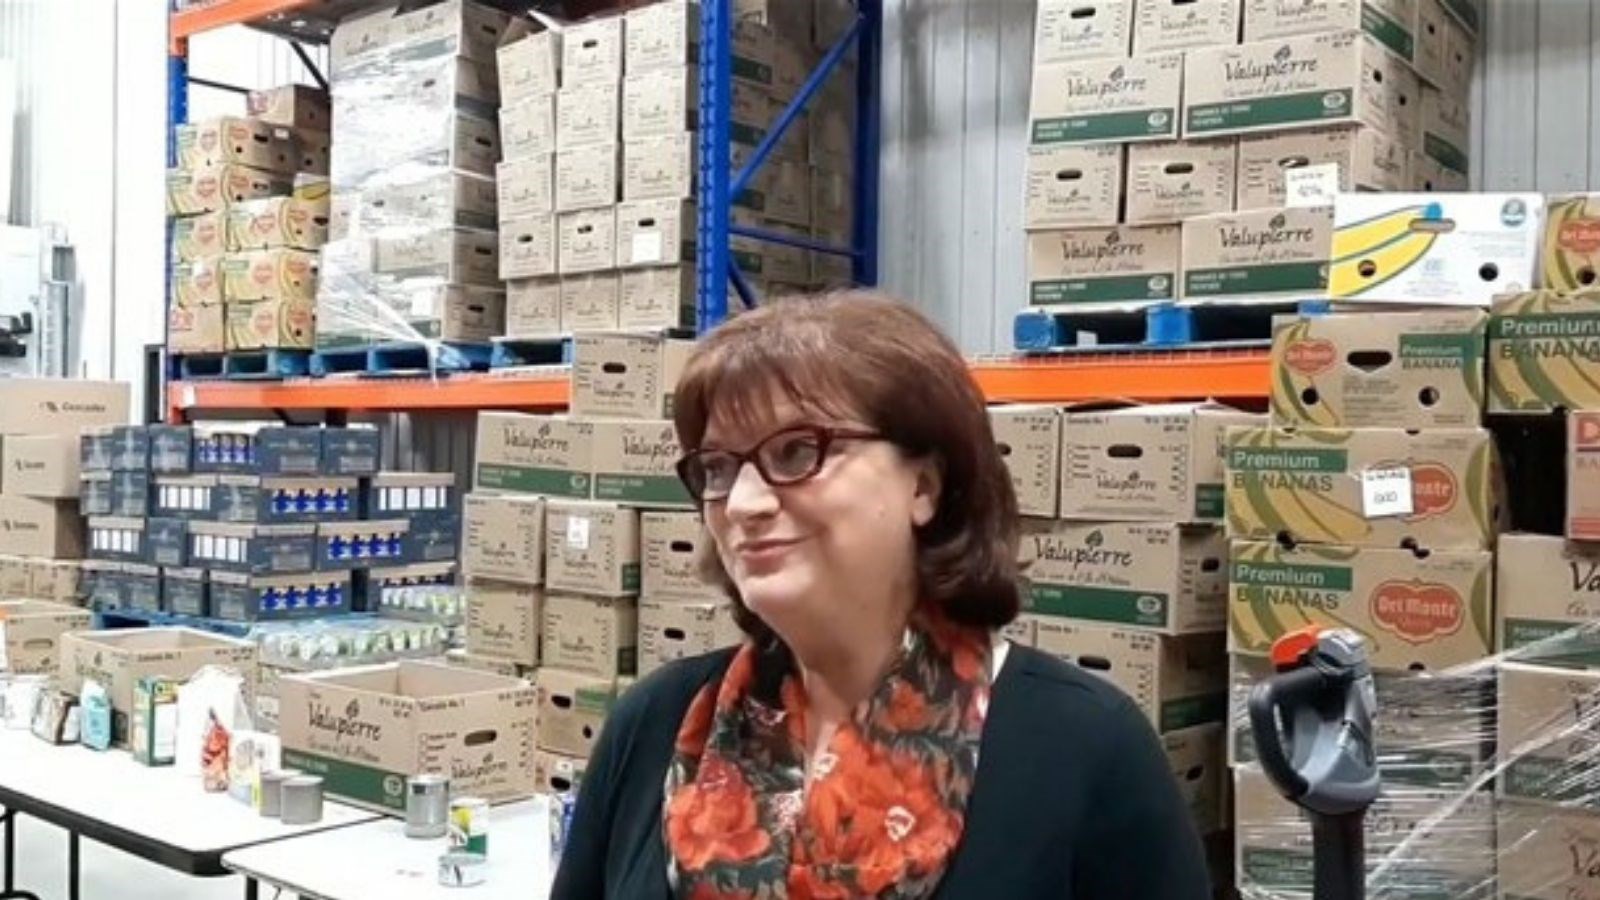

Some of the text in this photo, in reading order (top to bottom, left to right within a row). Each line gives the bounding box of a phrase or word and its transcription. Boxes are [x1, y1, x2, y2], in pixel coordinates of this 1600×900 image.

[1225, 58, 1317, 82] Valupierre
[1067, 76, 1146, 99] Valupierre
[1220, 226, 1313, 251] Valupierre
[1061, 240, 1144, 262] Valupierre
[1502, 318, 1600, 335] Premium
[1402, 357, 1461, 369] BANANA
[622, 435, 678, 461] Valupier
[1233, 451, 1320, 468] Premium
[1034, 536, 1132, 569] Valupierre
[1236, 565, 1325, 585] Premium
[1379, 596, 1404, 613] Del
[309, 700, 381, 741] Valupierre
